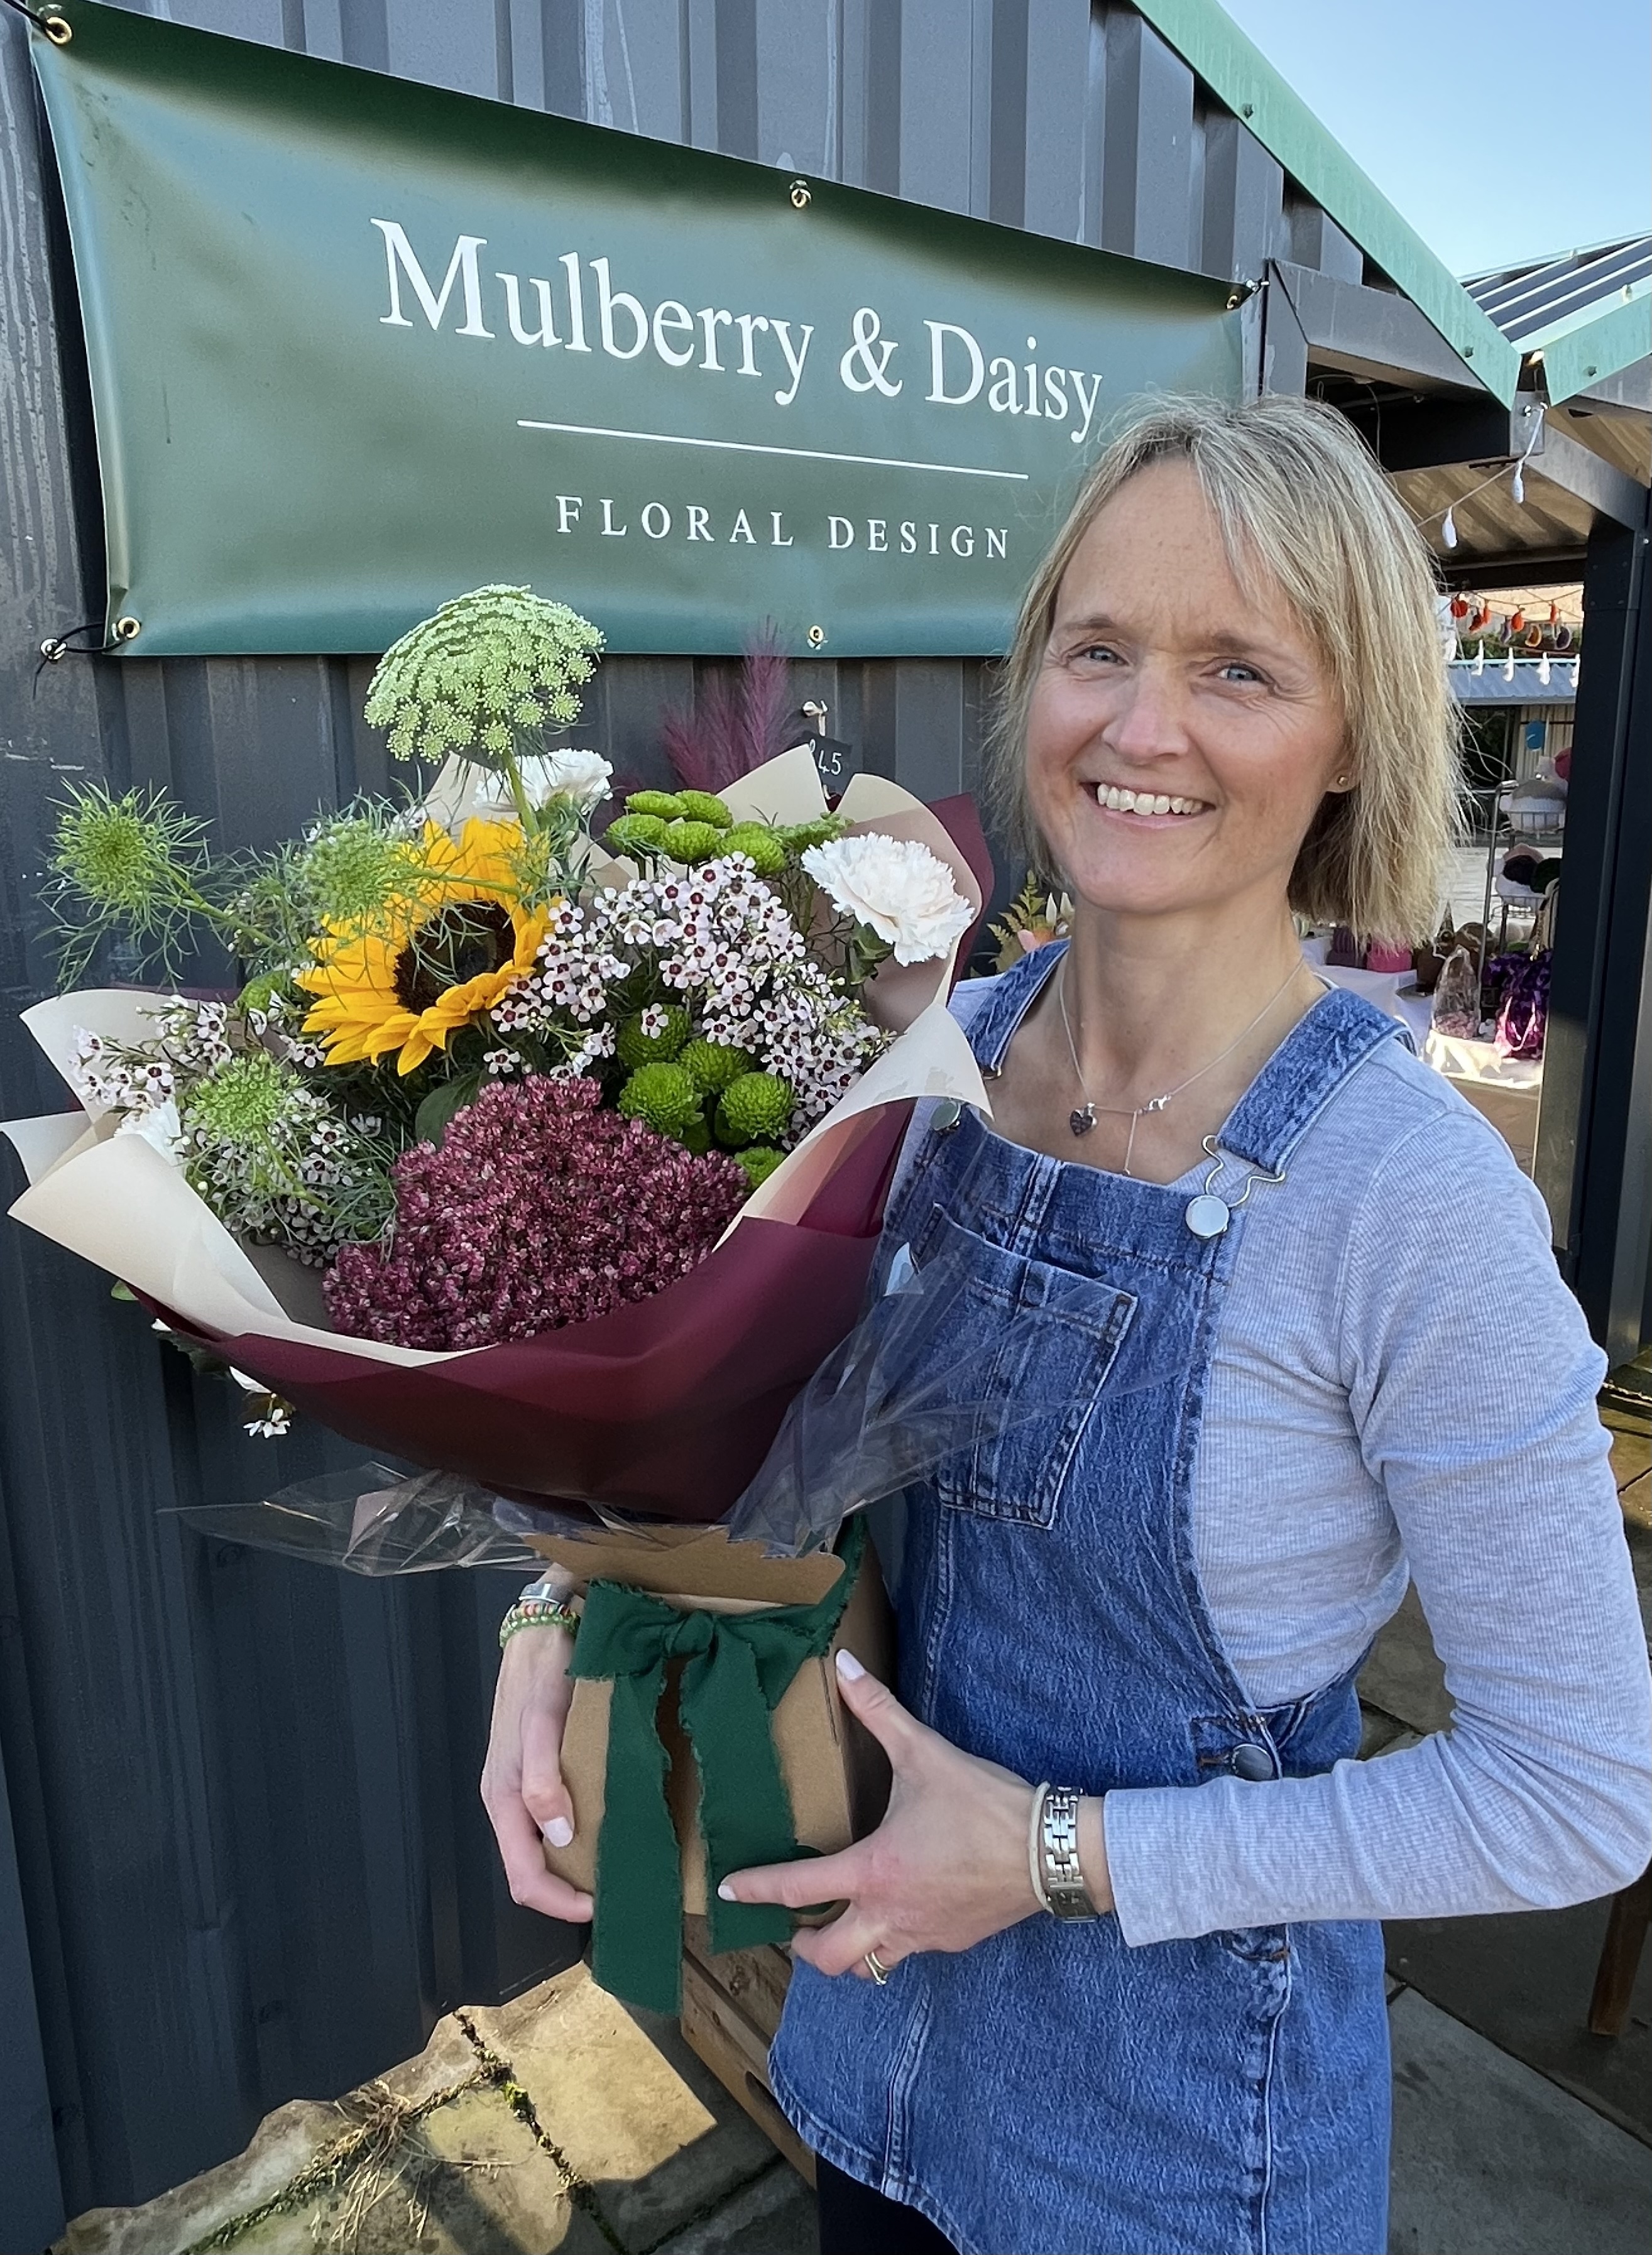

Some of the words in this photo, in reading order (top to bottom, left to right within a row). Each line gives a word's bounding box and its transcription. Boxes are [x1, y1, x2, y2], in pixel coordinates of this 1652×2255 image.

[369, 217, 815, 407] Mulberry
[840, 307, 903, 398] &
[922, 319, 1103, 444] Daisy
[555, 494, 794, 546] FLORAL
[828, 515, 1009, 559] DESIGN
